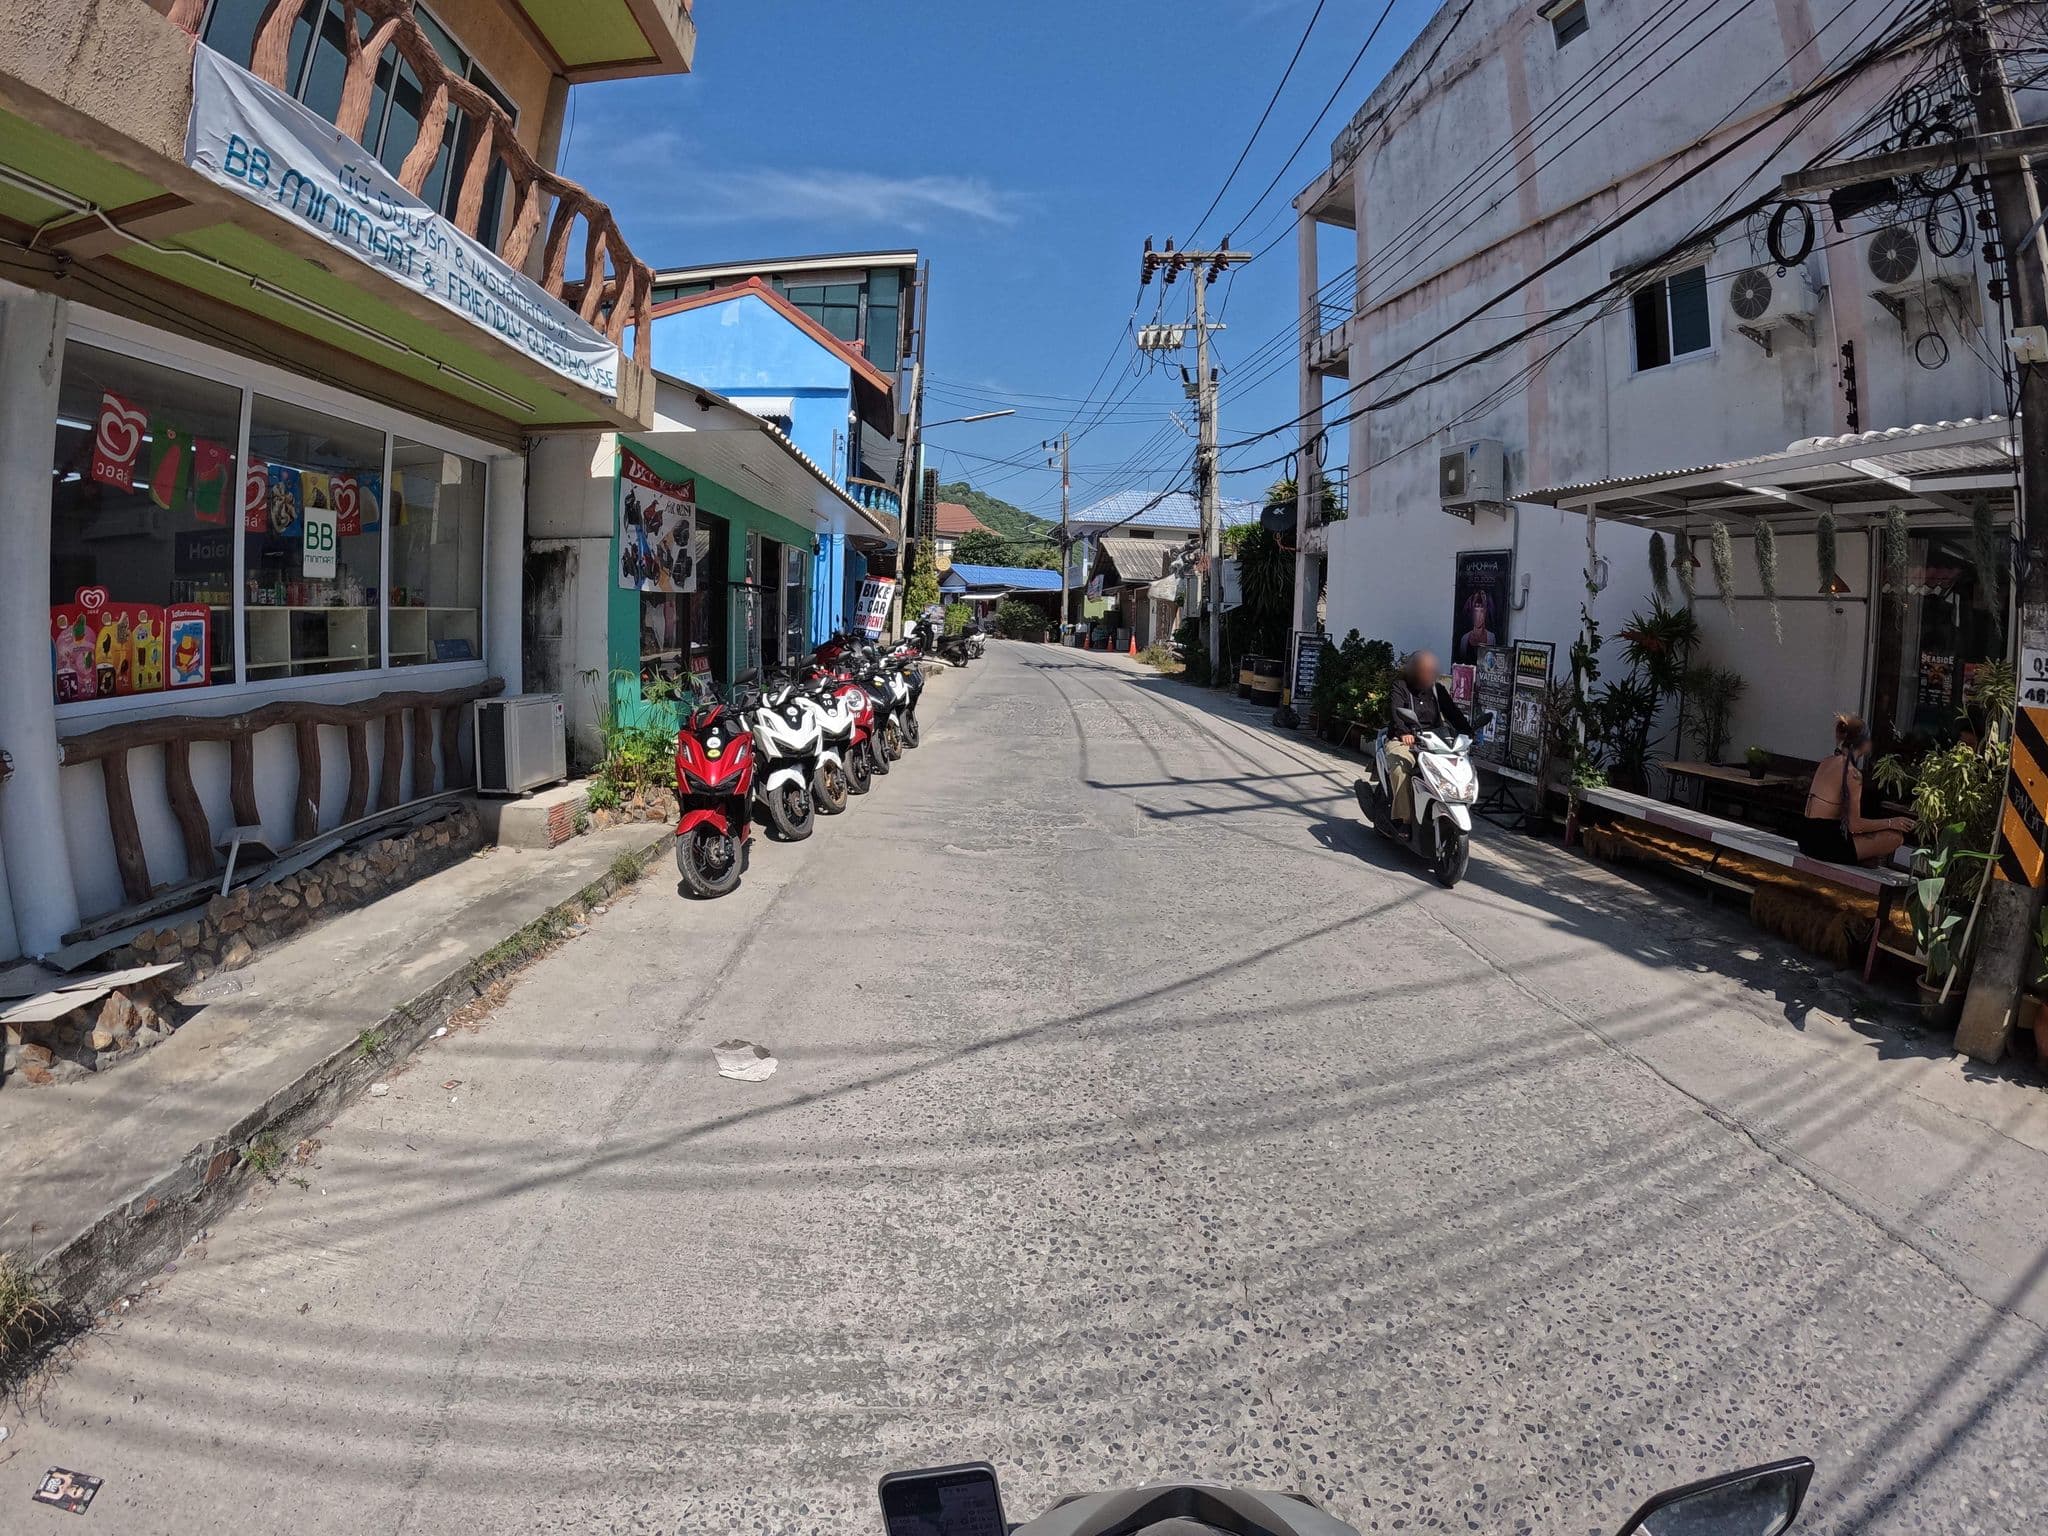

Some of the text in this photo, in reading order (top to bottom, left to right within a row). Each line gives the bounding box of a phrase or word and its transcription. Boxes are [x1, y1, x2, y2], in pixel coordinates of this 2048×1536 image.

[338, 163, 372, 204] บีบี
[454, 247, 465, 269] &
[223, 132, 617, 390] BB MINIMART & FRIENDLY GUESTHOUSE
[305, 520, 334, 551] BB
[862, 583, 891, 600] BIKE
[867, 600, 887, 615] CAR
[867, 614, 884, 628] RENT
[1519, 654, 1547, 670] JUNGLE
[1921, 653, 1955, 665] SEASIDE
[1513, 700, 1528, 721] 30
[711, 726, 719, 735] 3
